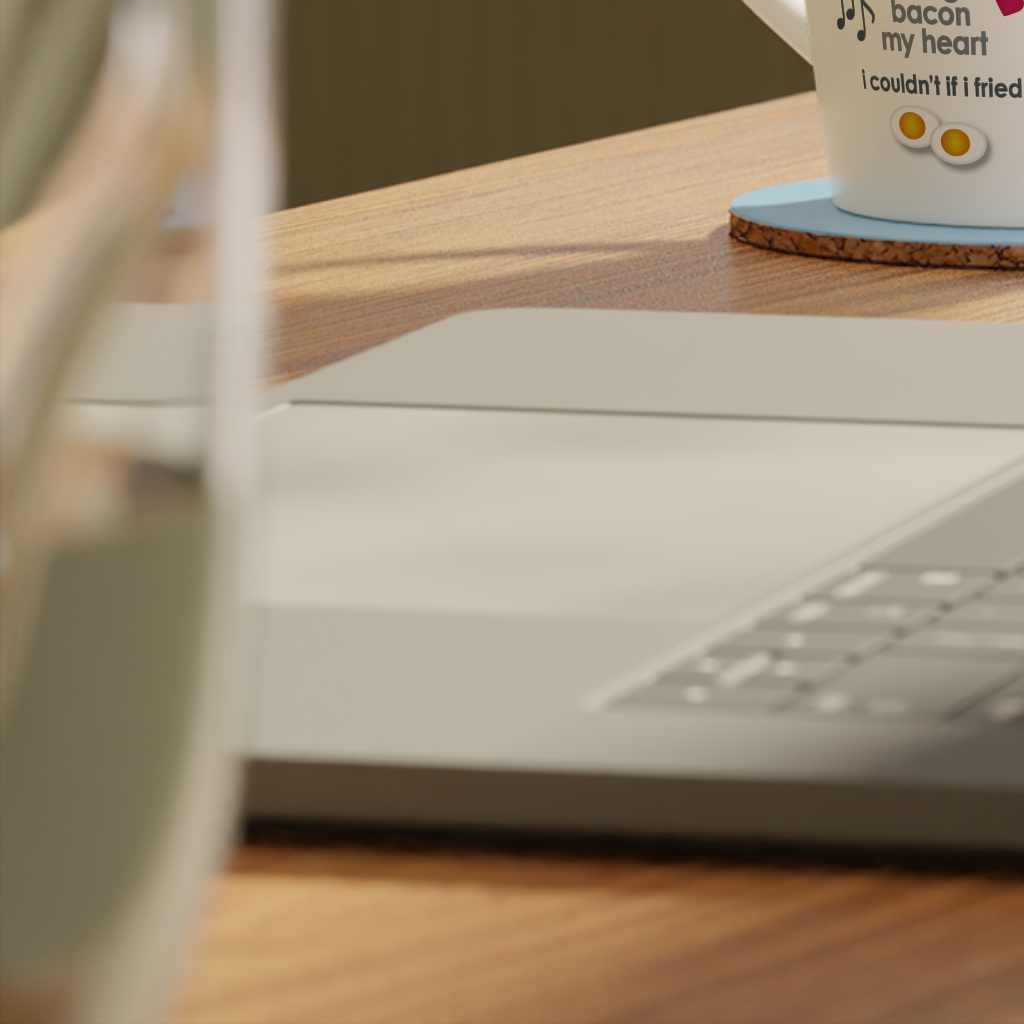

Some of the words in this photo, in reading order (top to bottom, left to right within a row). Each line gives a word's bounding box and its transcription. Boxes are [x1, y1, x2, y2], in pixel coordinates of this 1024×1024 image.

[881, 31, 915, 58] my
[921, 27, 989, 56] heart
[861, 68, 867, 90] i
[869, 73, 941, 95] couldn't
[945, 75, 958, 96] if
[963, 75, 969, 97] i
[973, 76, 1023, 98] fried
